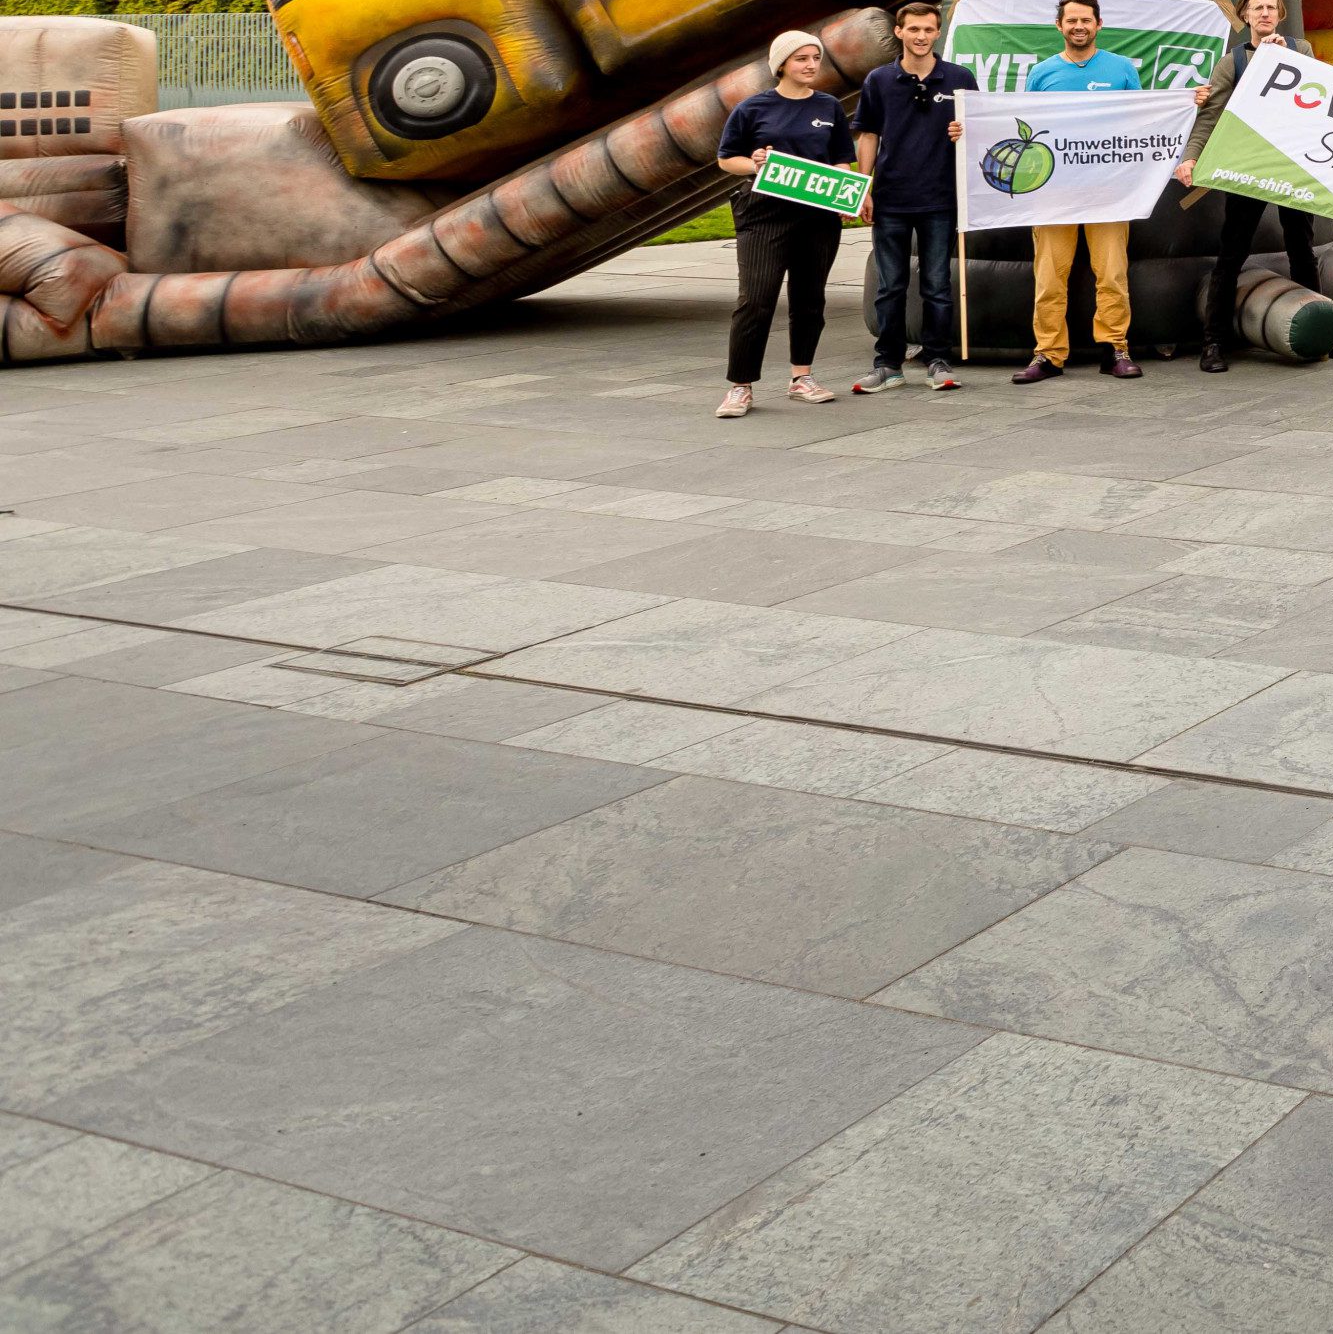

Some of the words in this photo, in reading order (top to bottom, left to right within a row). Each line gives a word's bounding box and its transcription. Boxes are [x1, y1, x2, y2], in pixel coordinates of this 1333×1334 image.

[1054, 134, 1183, 152] Umweltinstitut
[1063, 150, 1143, 165] München
[1152, 147, 1180, 162] e.V.
[764, 162, 805, 188] EXIT
[805, 173, 839, 196] ECT
